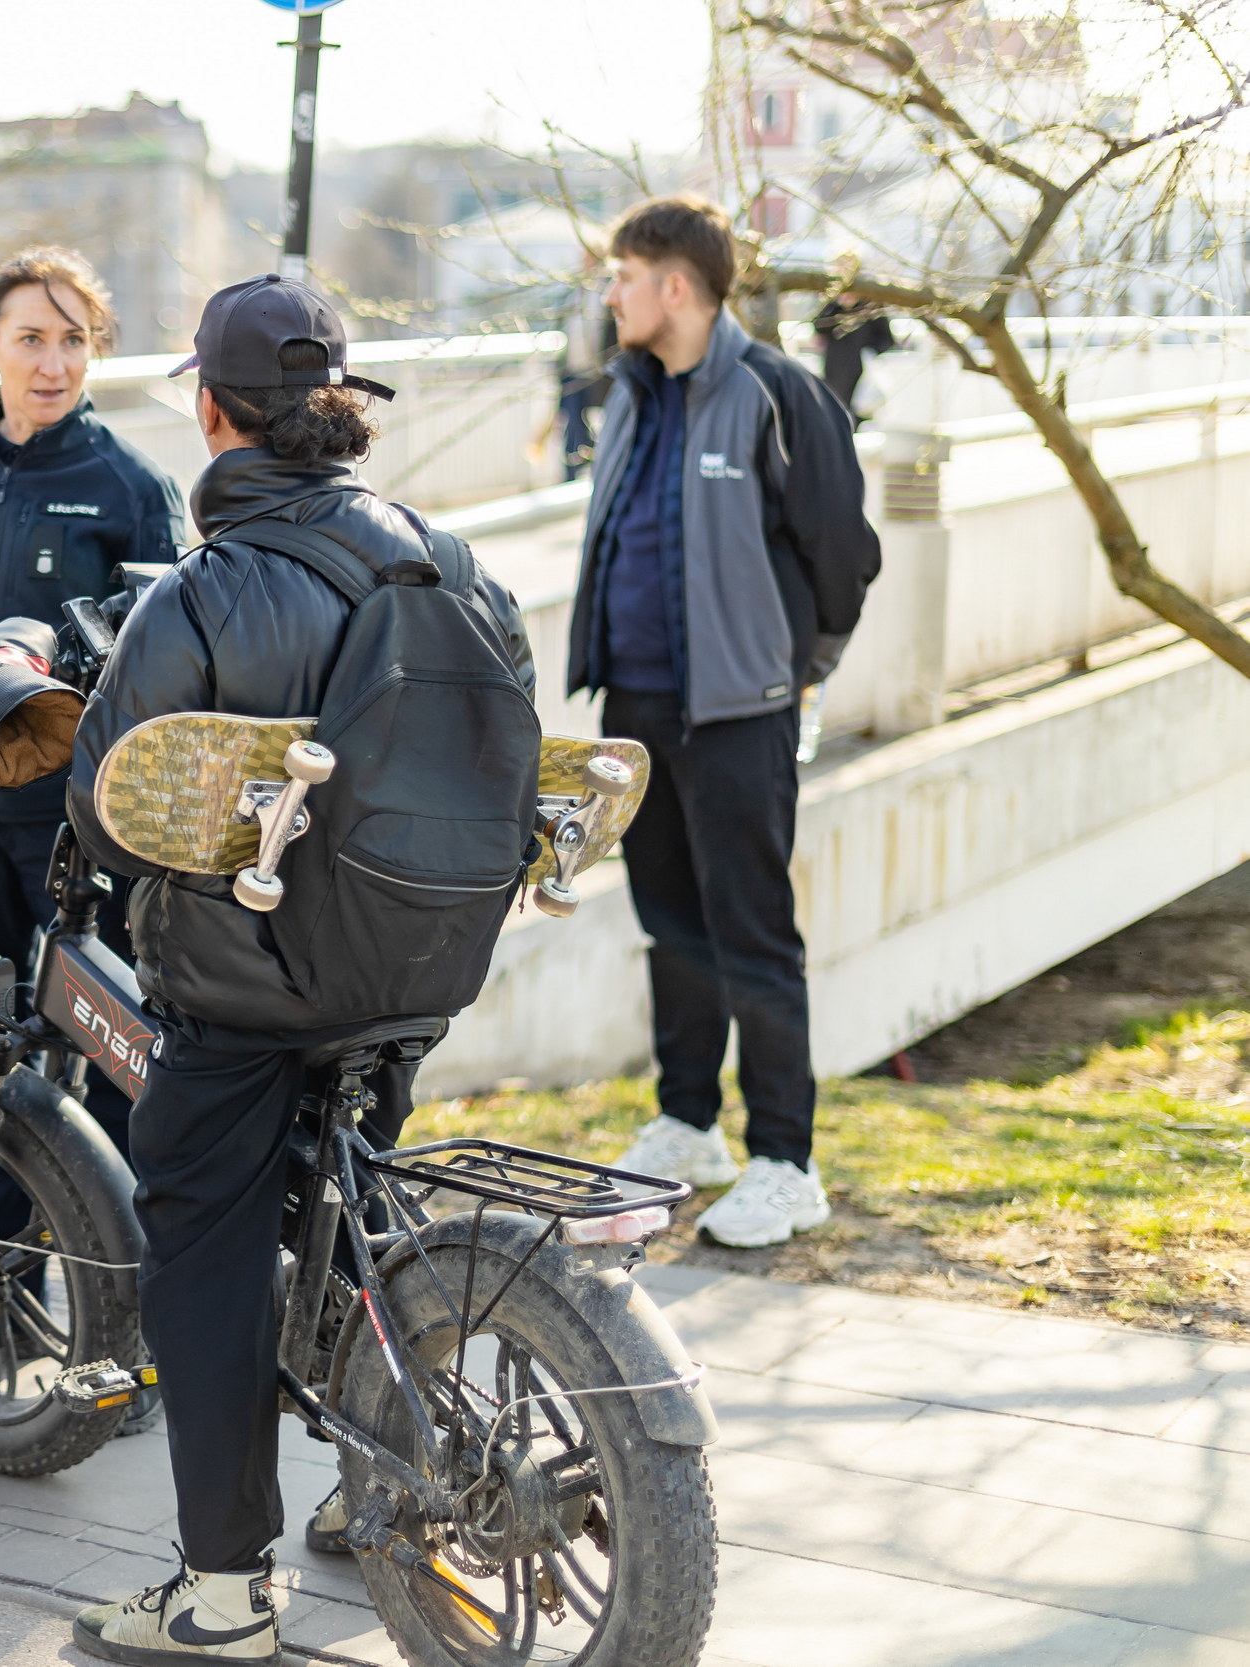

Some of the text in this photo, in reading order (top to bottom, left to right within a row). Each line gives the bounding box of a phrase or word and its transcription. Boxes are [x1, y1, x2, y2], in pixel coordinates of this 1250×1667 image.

[364, 1299, 384, 1339] POWER LIVE
[320, 1415, 376, 1461] Explore a New Way
